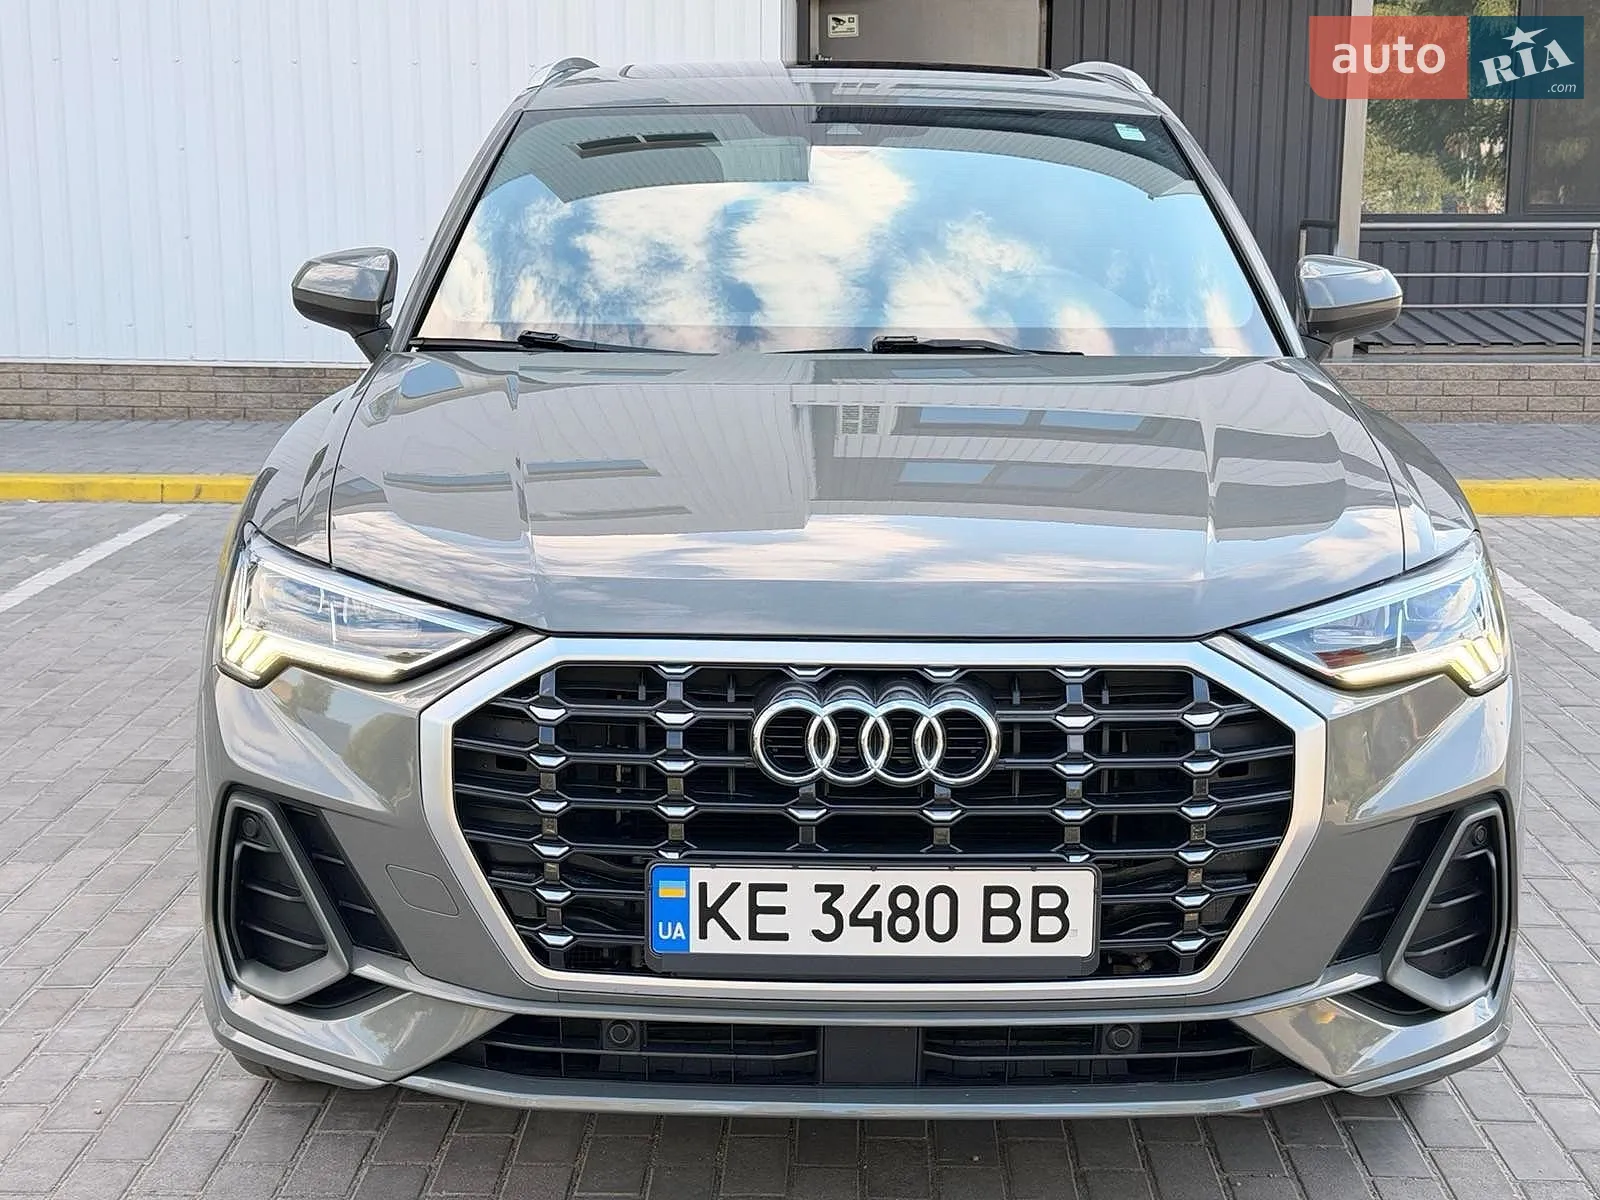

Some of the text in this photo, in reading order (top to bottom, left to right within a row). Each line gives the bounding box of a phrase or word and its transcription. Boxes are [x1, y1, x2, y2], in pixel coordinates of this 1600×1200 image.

[658, 921, 686, 940] UA
[698, 881, 1070, 944] KE 3480 BB
